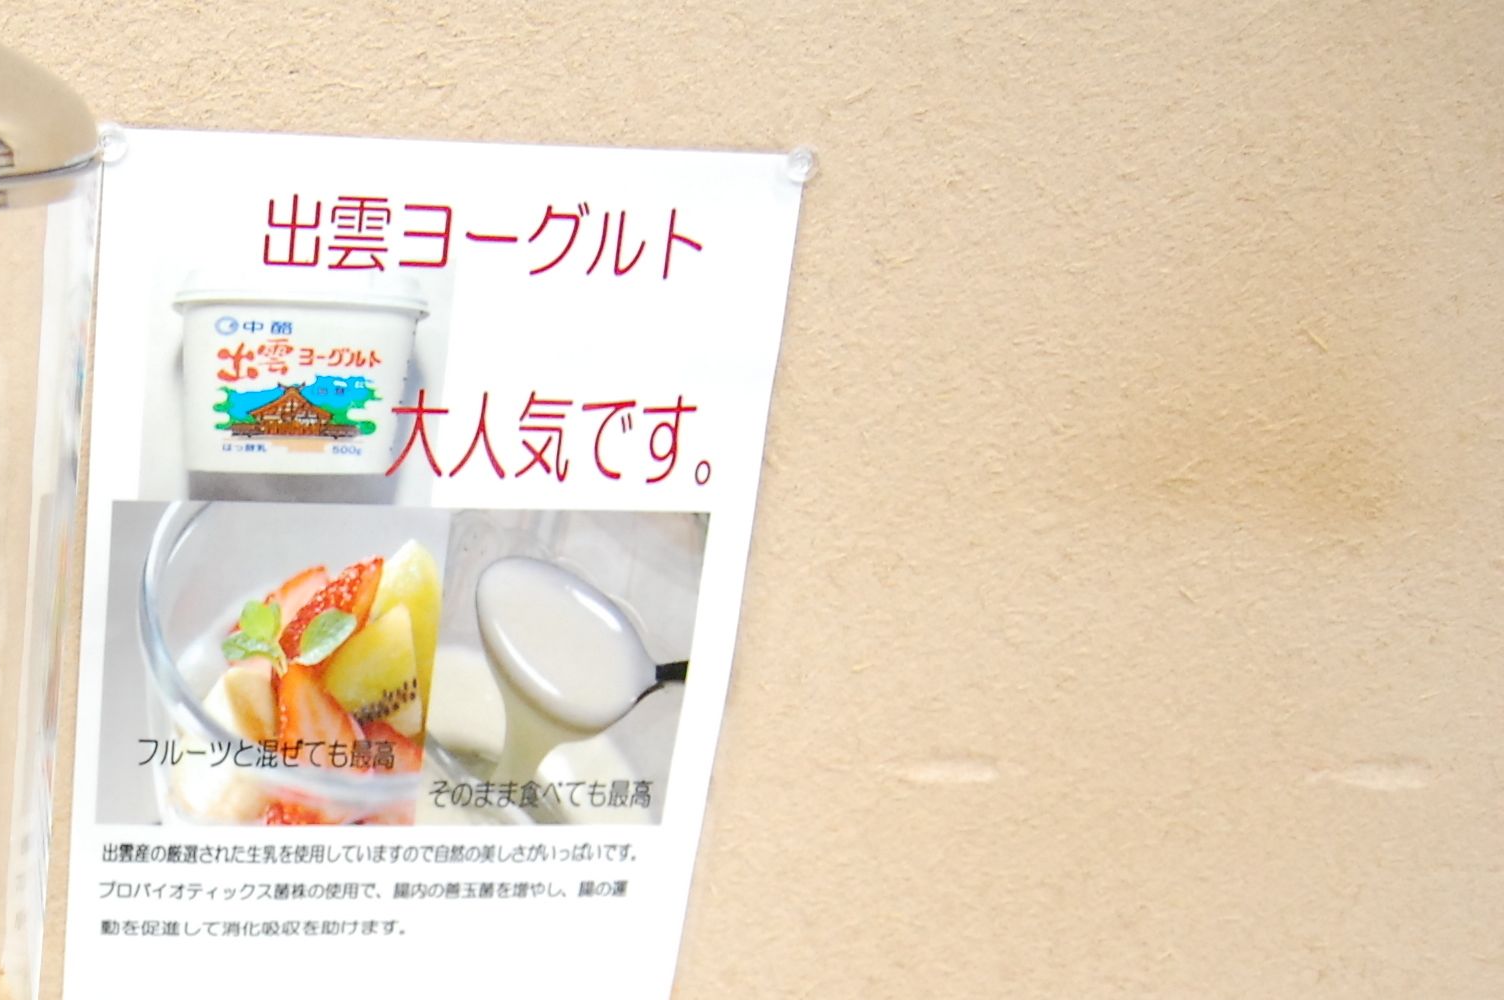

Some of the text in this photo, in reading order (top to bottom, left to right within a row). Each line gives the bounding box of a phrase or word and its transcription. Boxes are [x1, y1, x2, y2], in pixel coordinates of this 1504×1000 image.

[262, 193, 703, 280] 出雲ヨーグルト
[384, 388, 712, 486] 大人気です。
[138, 739, 396, 769] フルーツと混ぜても最高
[429, 780, 654, 808] そのまま食べても最高
